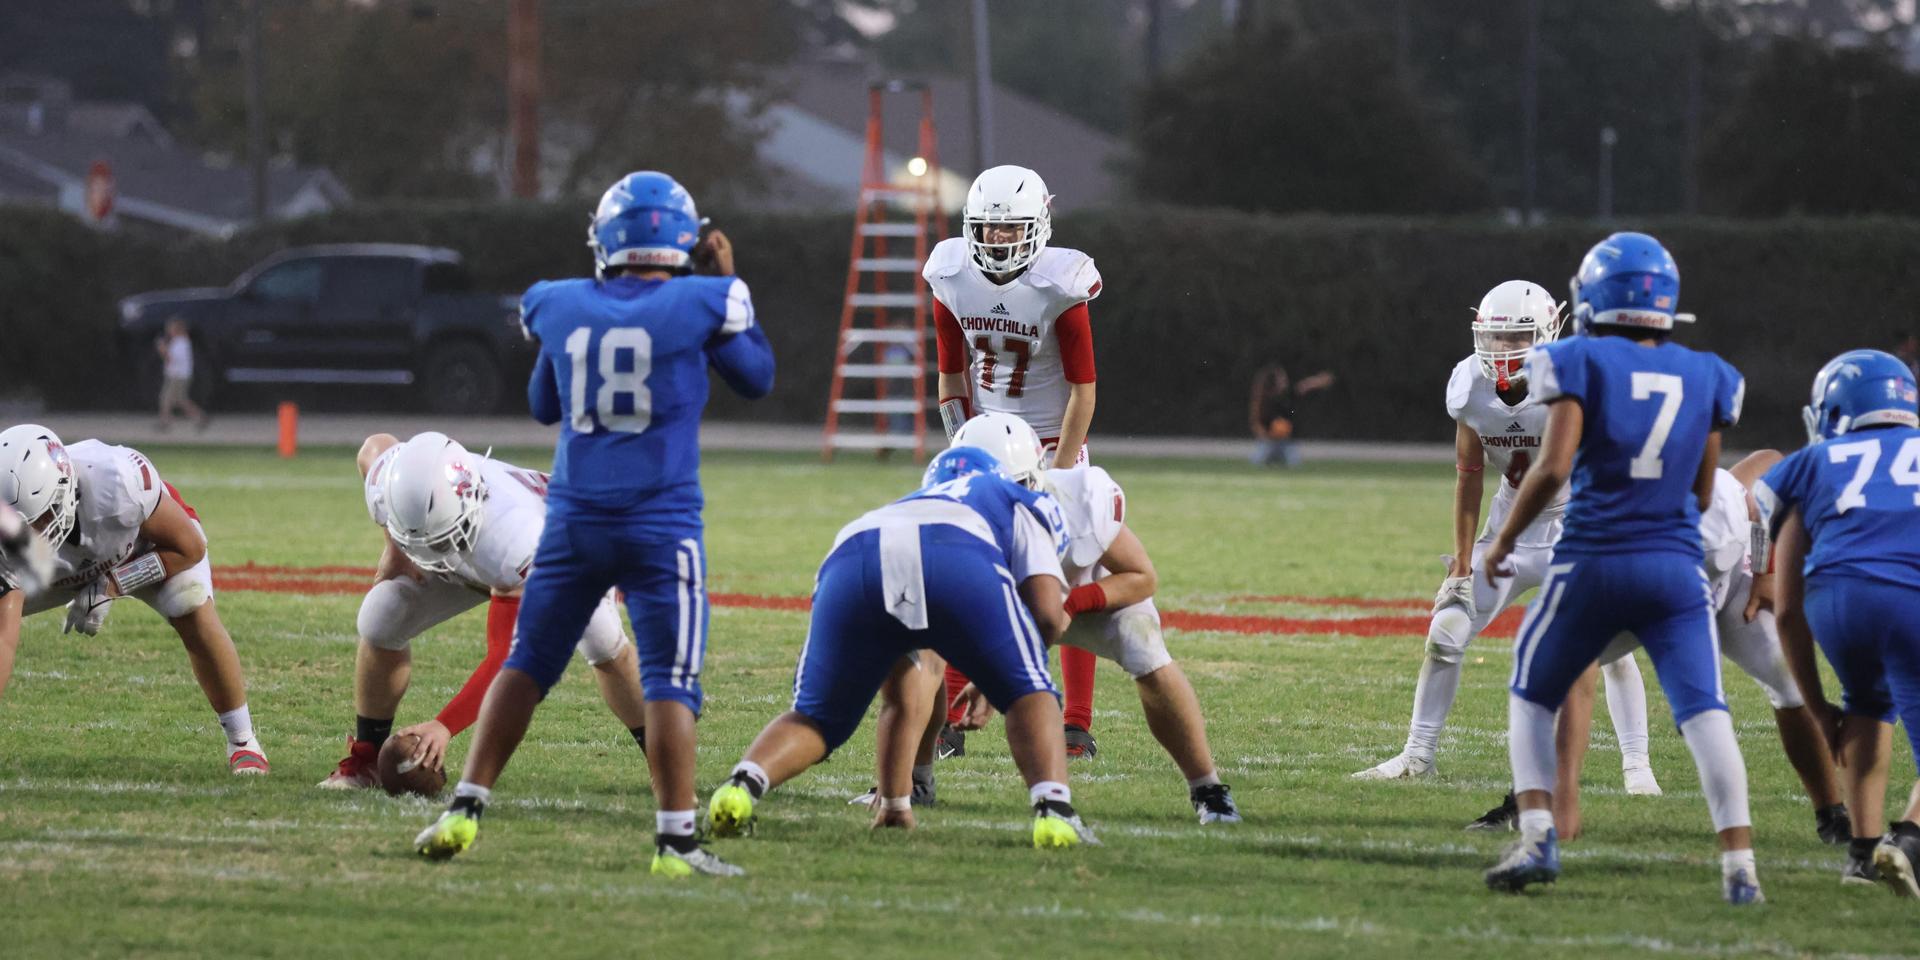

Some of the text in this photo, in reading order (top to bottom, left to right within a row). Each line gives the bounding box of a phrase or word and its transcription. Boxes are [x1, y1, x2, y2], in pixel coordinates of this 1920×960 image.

[961, 317, 1039, 338] CHOWCHILLA
[565, 327, 652, 434] 18
[974, 334, 1031, 399] 17
[1481, 435, 1543, 448] CHOWCHIL
[1630, 371, 1683, 479] 7
[1508, 448, 1532, 490] 4
[1827, 436, 1920, 516] 74
